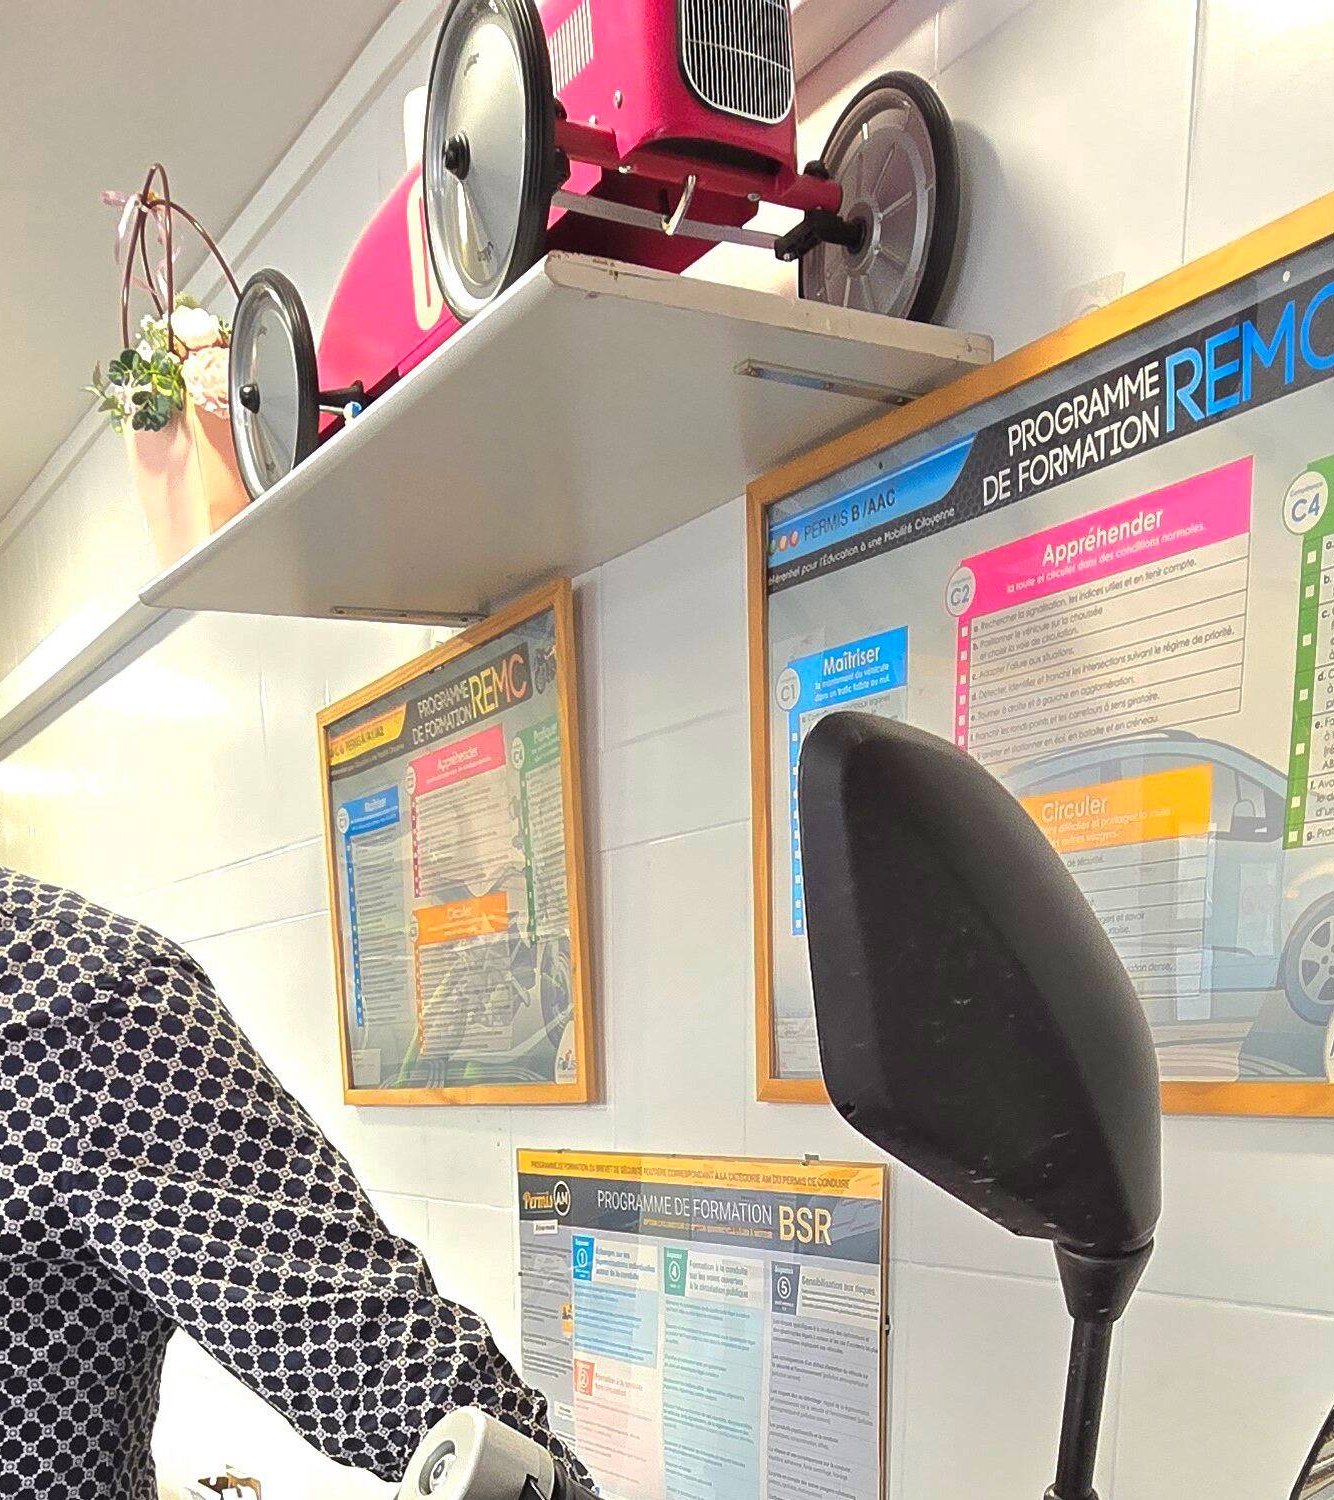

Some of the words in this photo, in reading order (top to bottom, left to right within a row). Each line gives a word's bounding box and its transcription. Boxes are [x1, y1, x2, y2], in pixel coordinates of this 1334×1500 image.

[1008, 361, 1159, 456] PROGRAMME
[983, 469, 1011, 506] DE
[1018, 406, 1159, 493] FORMATION
[804, 509, 849, 541] PERMIS
[851, 505, 860, 522] B
[862, 488, 896, 519] /AAC
[1291, 492, 1320, 522] C4
[801, 560, 818, 577] pour
[860, 539, 866, 551] à
[868, 536, 882, 548] une
[884, 521, 913, 542] Mobilité
[914, 509, 955, 531] Citoyenne
[1042, 509, 1163, 568] Appréhender
[1325, 539, 1334, 550] a.
[1077, 558, 1097, 571] dans
[1098, 553, 1114, 564] des
[1115, 538, 1159, 559] conditions
[1079, 587, 1105, 602] indices
[1105, 580, 1123, 594] utiles
[1124, 576, 1133, 588] et
[1133, 575, 1144, 585] en
[1163, 559, 1197, 577] compte.
[1323, 571, 1331, 585] b.
[951, 583, 970, 607] C2
[1069, 605, 1103, 623] chaussée
[1321, 609, 1330, 619] c.
[1082, 655, 1126, 673] intersections
[1126, 646, 1154, 662] suivant
[1155, 644, 1162, 655] le
[1163, 639, 1190, 654] régime
[1192, 634, 1203, 646] de
[1204, 625, 1235, 646] priorité.
[823, 647, 880, 676] Maîtriser
[468, 653, 527, 719] REMC
[1317, 669, 1326, 682] d.
[1326, 681, 1334, 694] à
[418, 680, 469, 719] PROGRAMME
[781, 684, 796, 702] C1
[412, 728, 424, 745] DE
[425, 704, 473, 739] FORMATION
[1314, 719, 1324, 729] e.
[1323, 728, 1330, 741] à
[1041, 795, 1108, 823] Circuler
[1317, 791, 1327, 803] le
[1306, 830, 1315, 843] g.
[782, 1175, 807, 1186] PERMIS
[808, 1177, 817, 1187] DE
[818, 1178, 850, 1188] CONDUIRE
[523, 1191, 553, 1209] Permis
[598, 1190, 671, 1215] PROGRAMME
[674, 1198, 690, 1217] DE
[694, 1199, 772, 1225] FORMATION
[779, 1205, 832, 1246] BSR
[780, 1280, 788, 1296] 5
[801, 1275, 843, 1290] Sensibilisation
